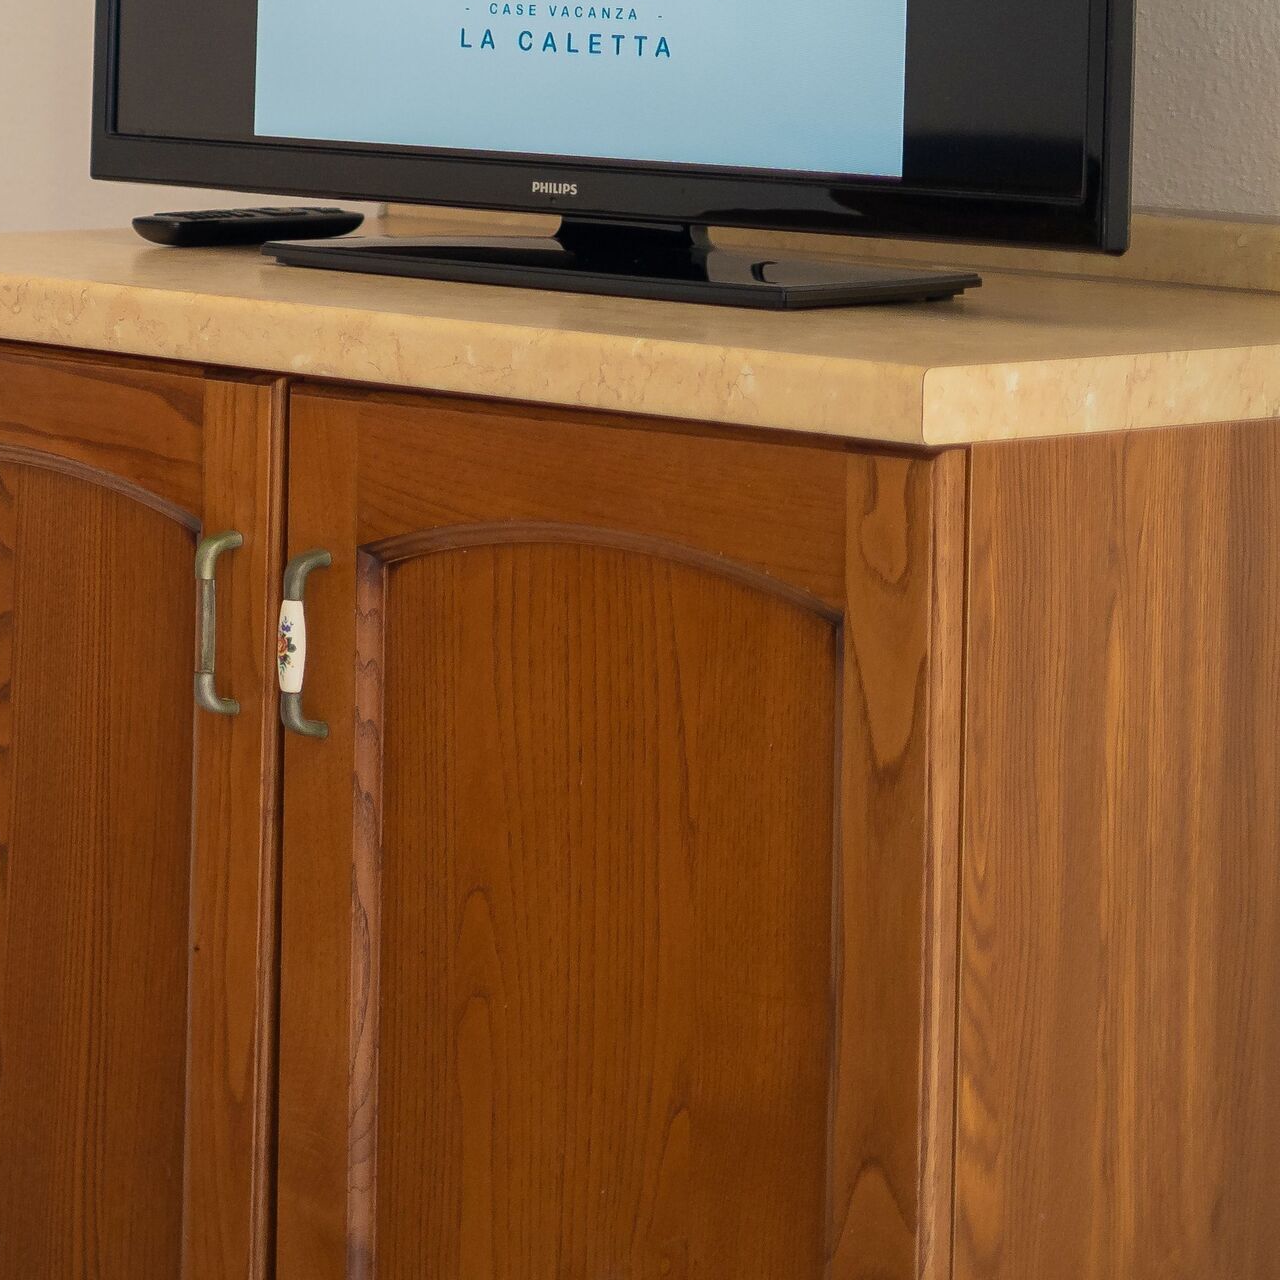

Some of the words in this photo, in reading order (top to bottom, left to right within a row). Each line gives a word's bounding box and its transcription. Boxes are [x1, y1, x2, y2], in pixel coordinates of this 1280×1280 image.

[489, 2, 537, 17] CASE
[548, 5, 638, 21] VACANZA
[460, 27, 496, 50] LA
[518, 30, 671, 59] CALETTA
[531, 181, 578, 196] PHILIPS
